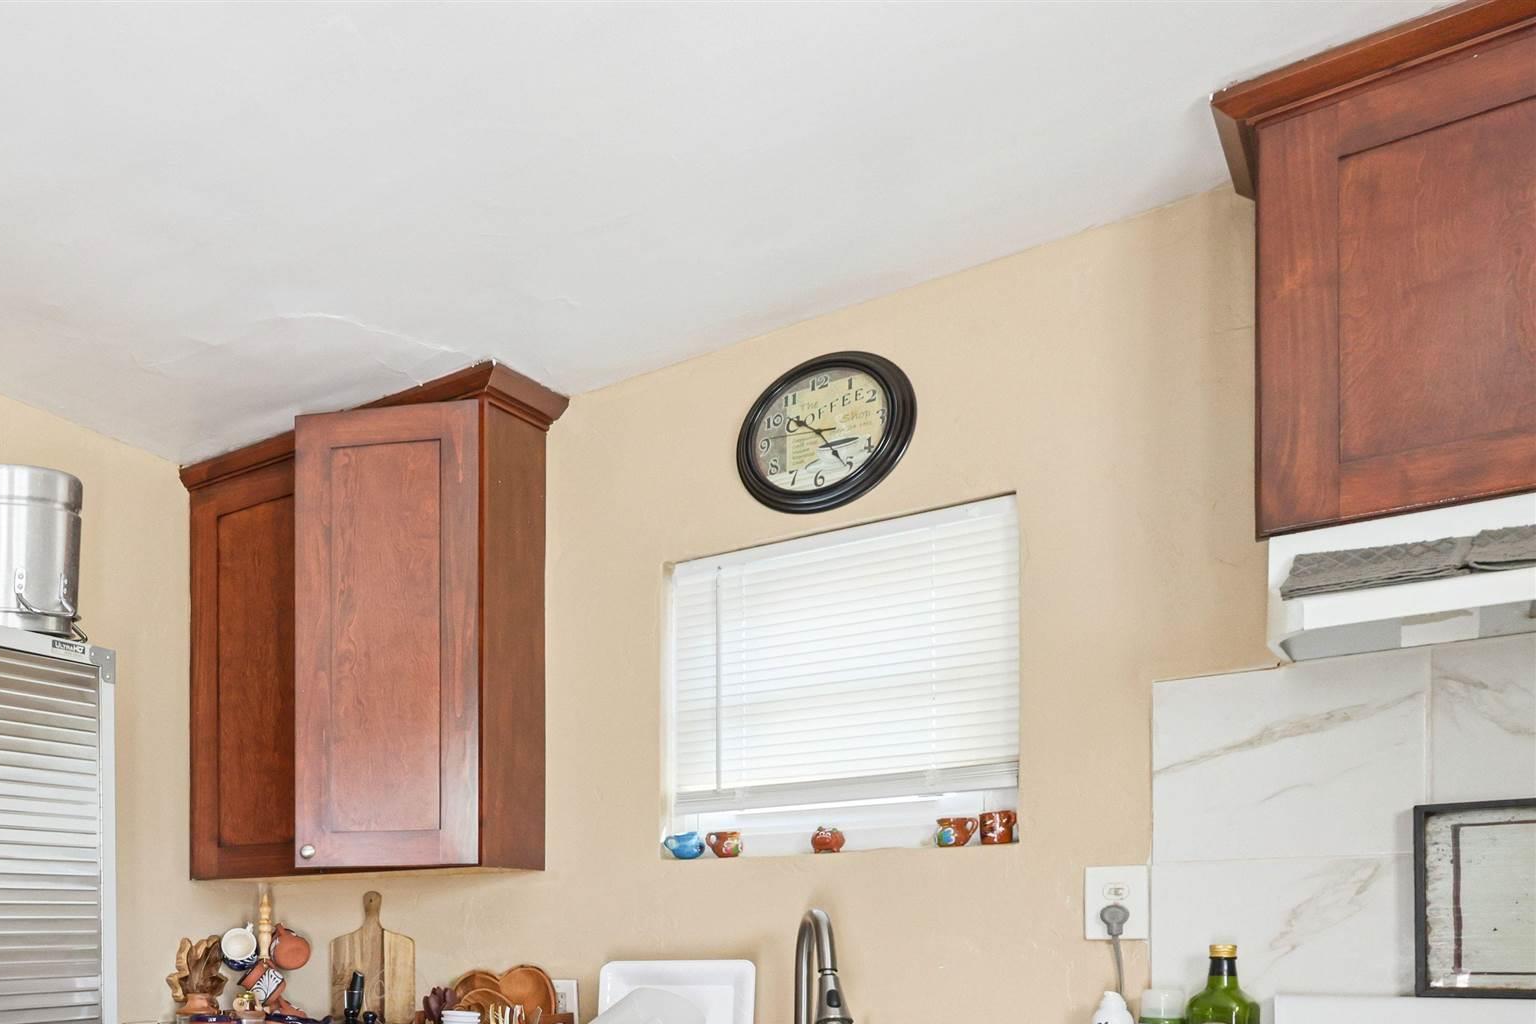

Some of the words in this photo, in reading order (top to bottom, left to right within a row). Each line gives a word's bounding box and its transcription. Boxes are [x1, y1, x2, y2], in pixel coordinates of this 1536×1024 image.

[811, 375, 829, 391] 12
[848, 377, 853, 390] 1
[784, 393, 797, 407] 11
[865, 389, 877, 403] 2
[766, 414, 783, 429] 10
[760, 438, 770, 457] 9
[769, 458, 779, 475] 8
[789, 469, 799, 486] 7
[814, 469, 825, 487] 6
